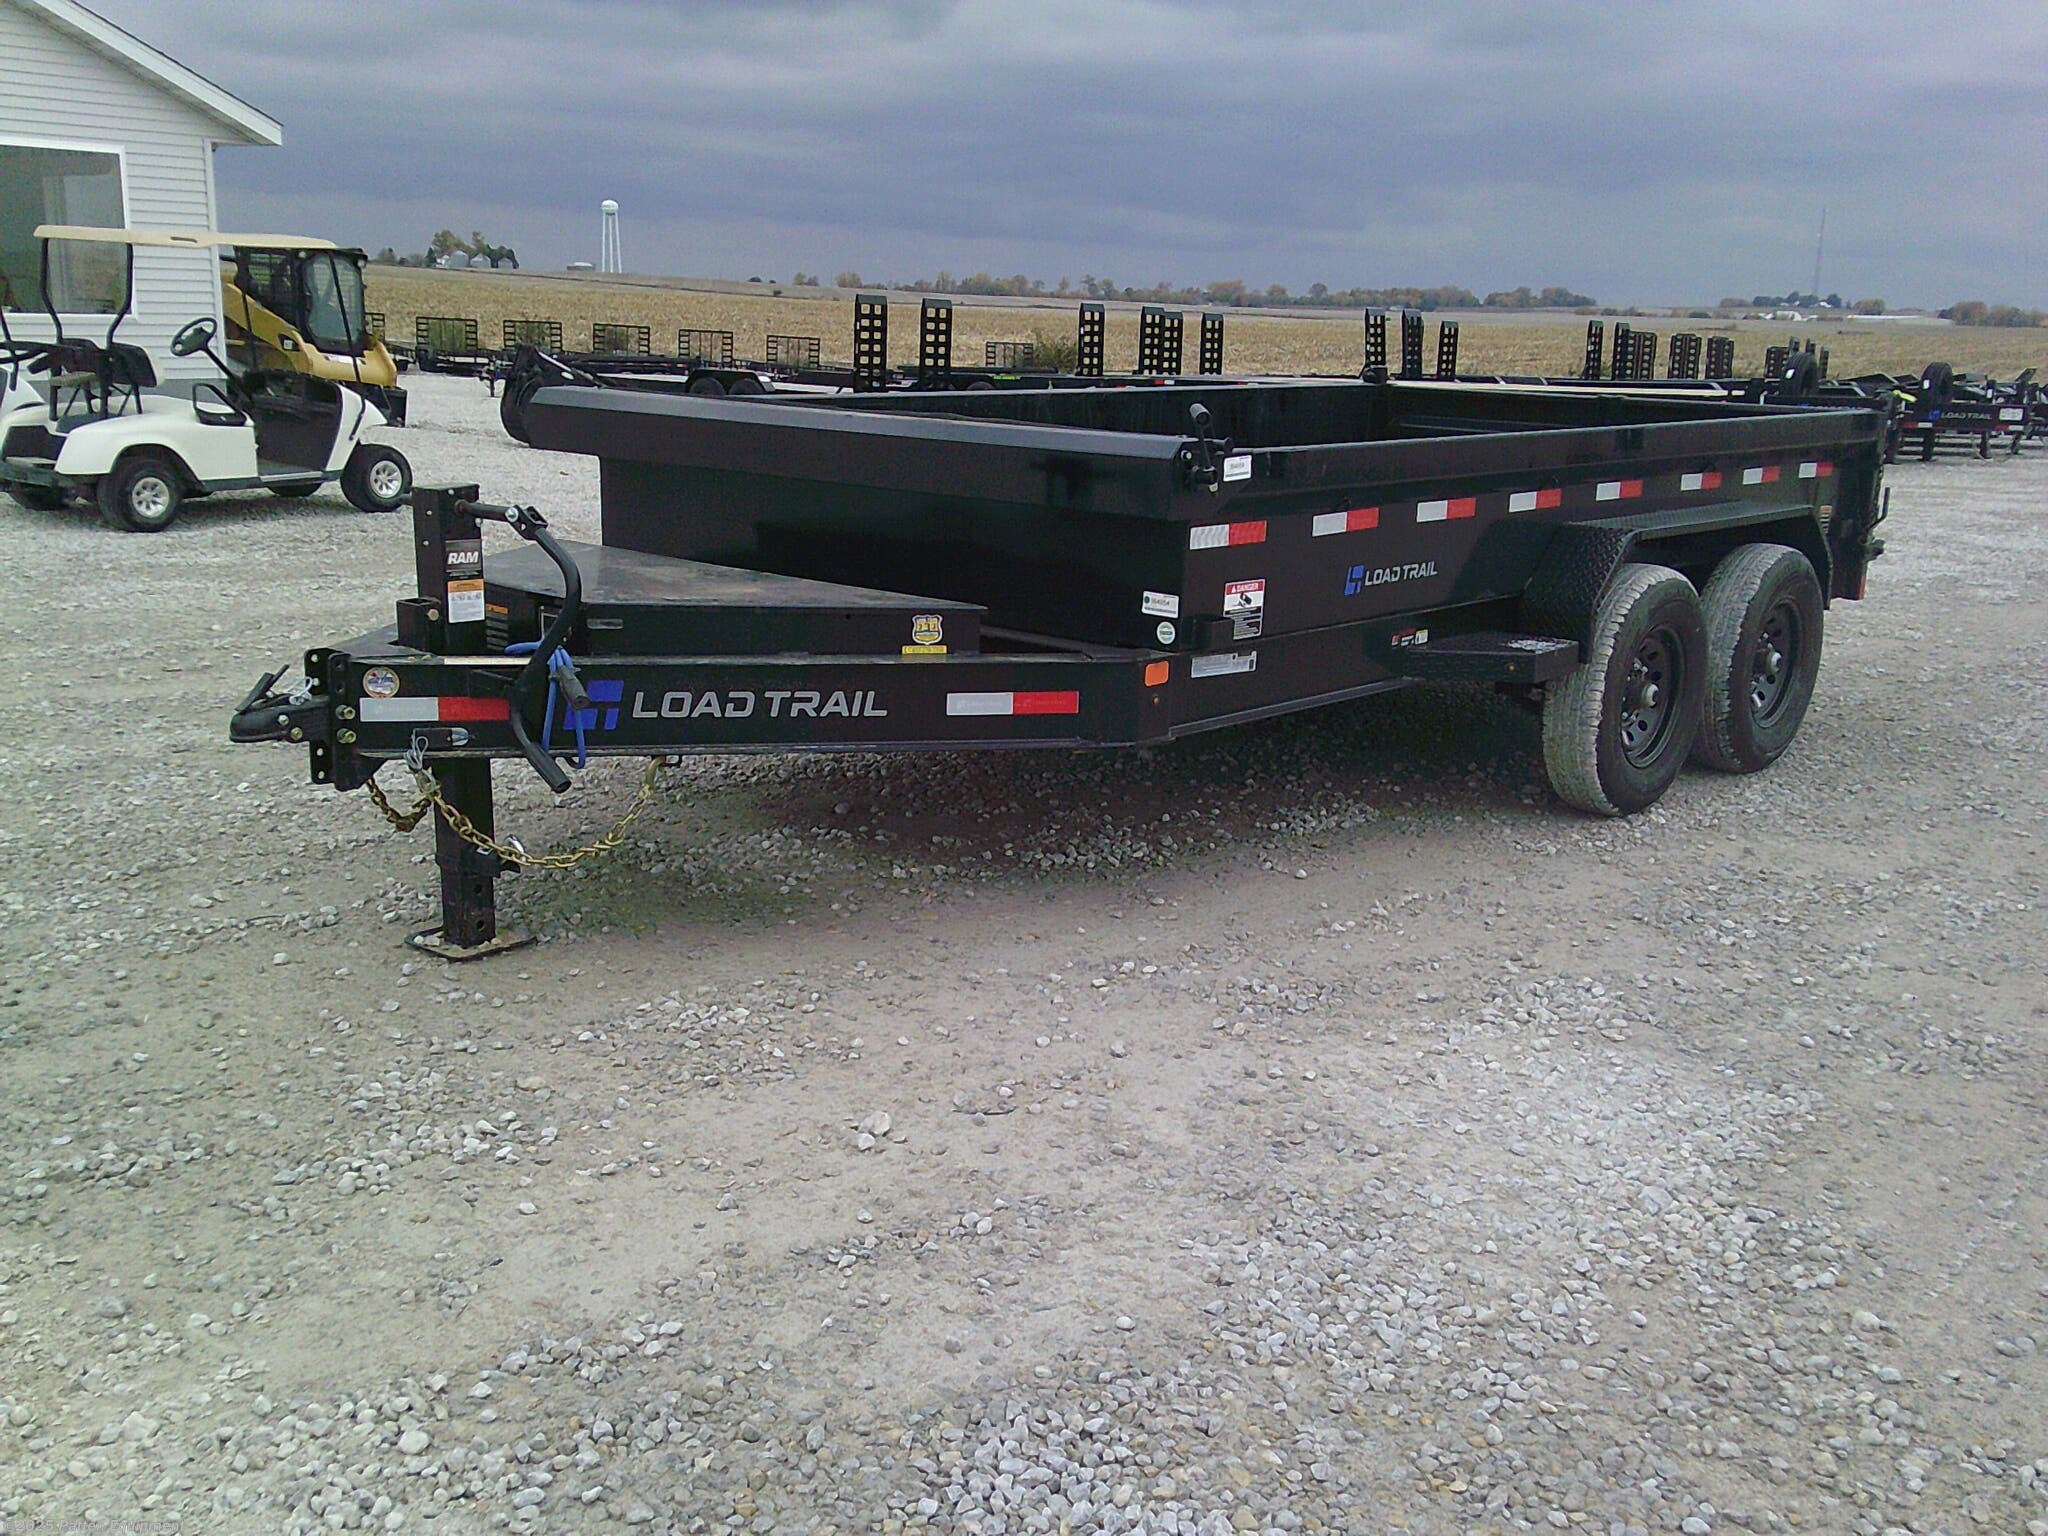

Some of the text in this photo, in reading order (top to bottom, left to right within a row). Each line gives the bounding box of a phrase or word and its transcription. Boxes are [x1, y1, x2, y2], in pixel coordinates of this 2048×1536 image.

[448, 551, 479, 565] RAM
[1364, 560, 1438, 586] LOAD TRAIL
[632, 690, 889, 719] LOAD TRAIL
